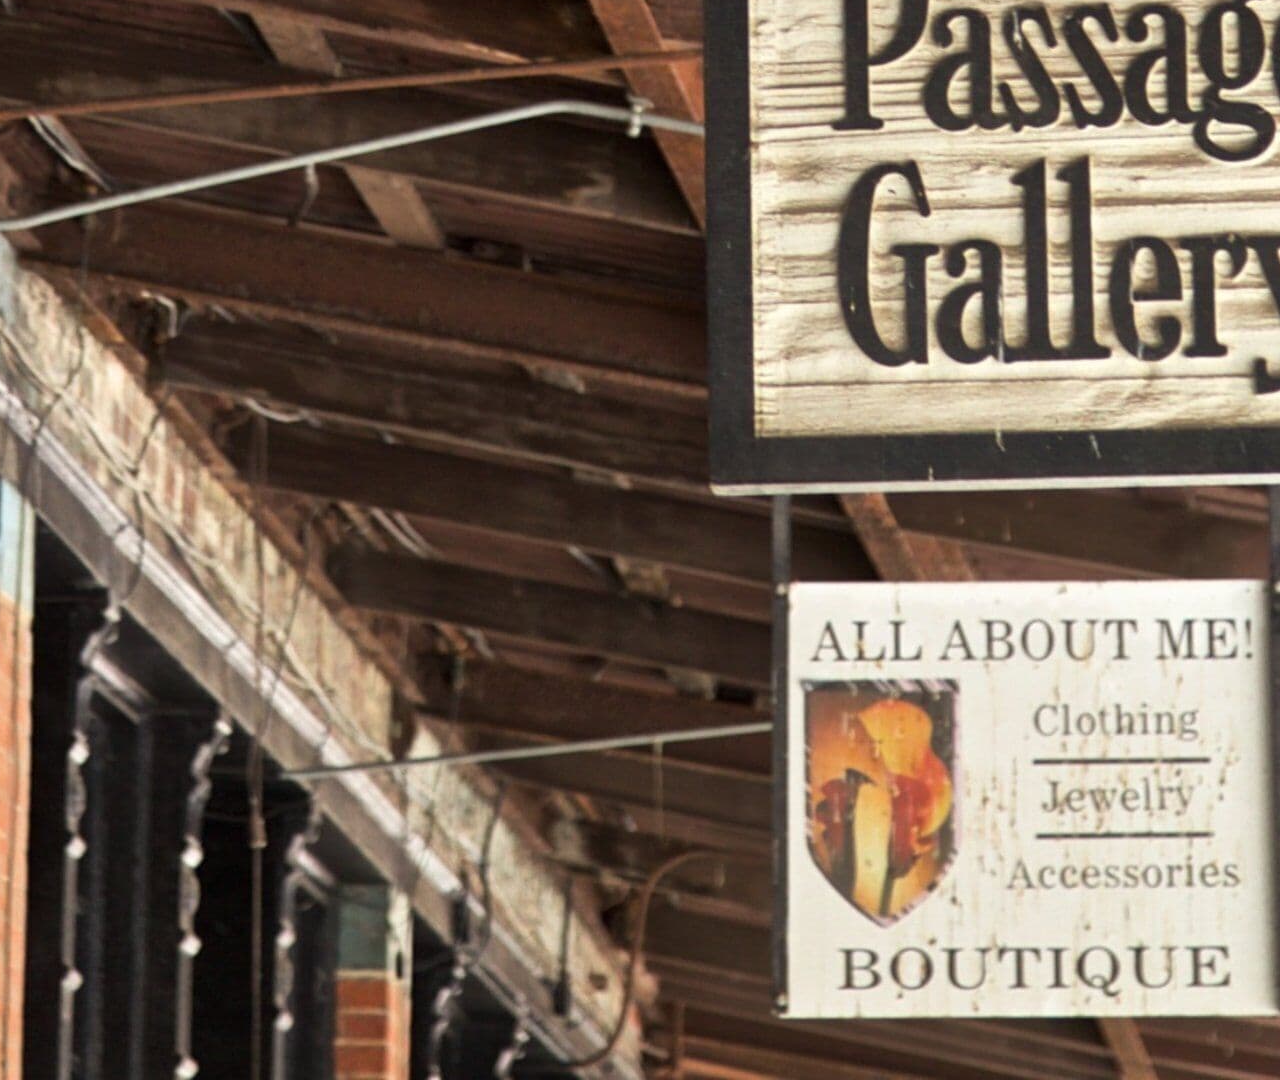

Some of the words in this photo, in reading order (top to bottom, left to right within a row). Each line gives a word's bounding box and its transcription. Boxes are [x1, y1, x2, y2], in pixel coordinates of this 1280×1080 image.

[810, 619, 923, 663] ALL
[938, 619, 1138, 662] ABOUT
[1156, 617, 1255, 660] ME!
[1032, 703, 1200, 742] Clothing
[1040, 779, 1196, 815] Jewelry
[1006, 856, 1242, 891] Accessories
[837, 944, 1232, 998] BOUTIQUE
